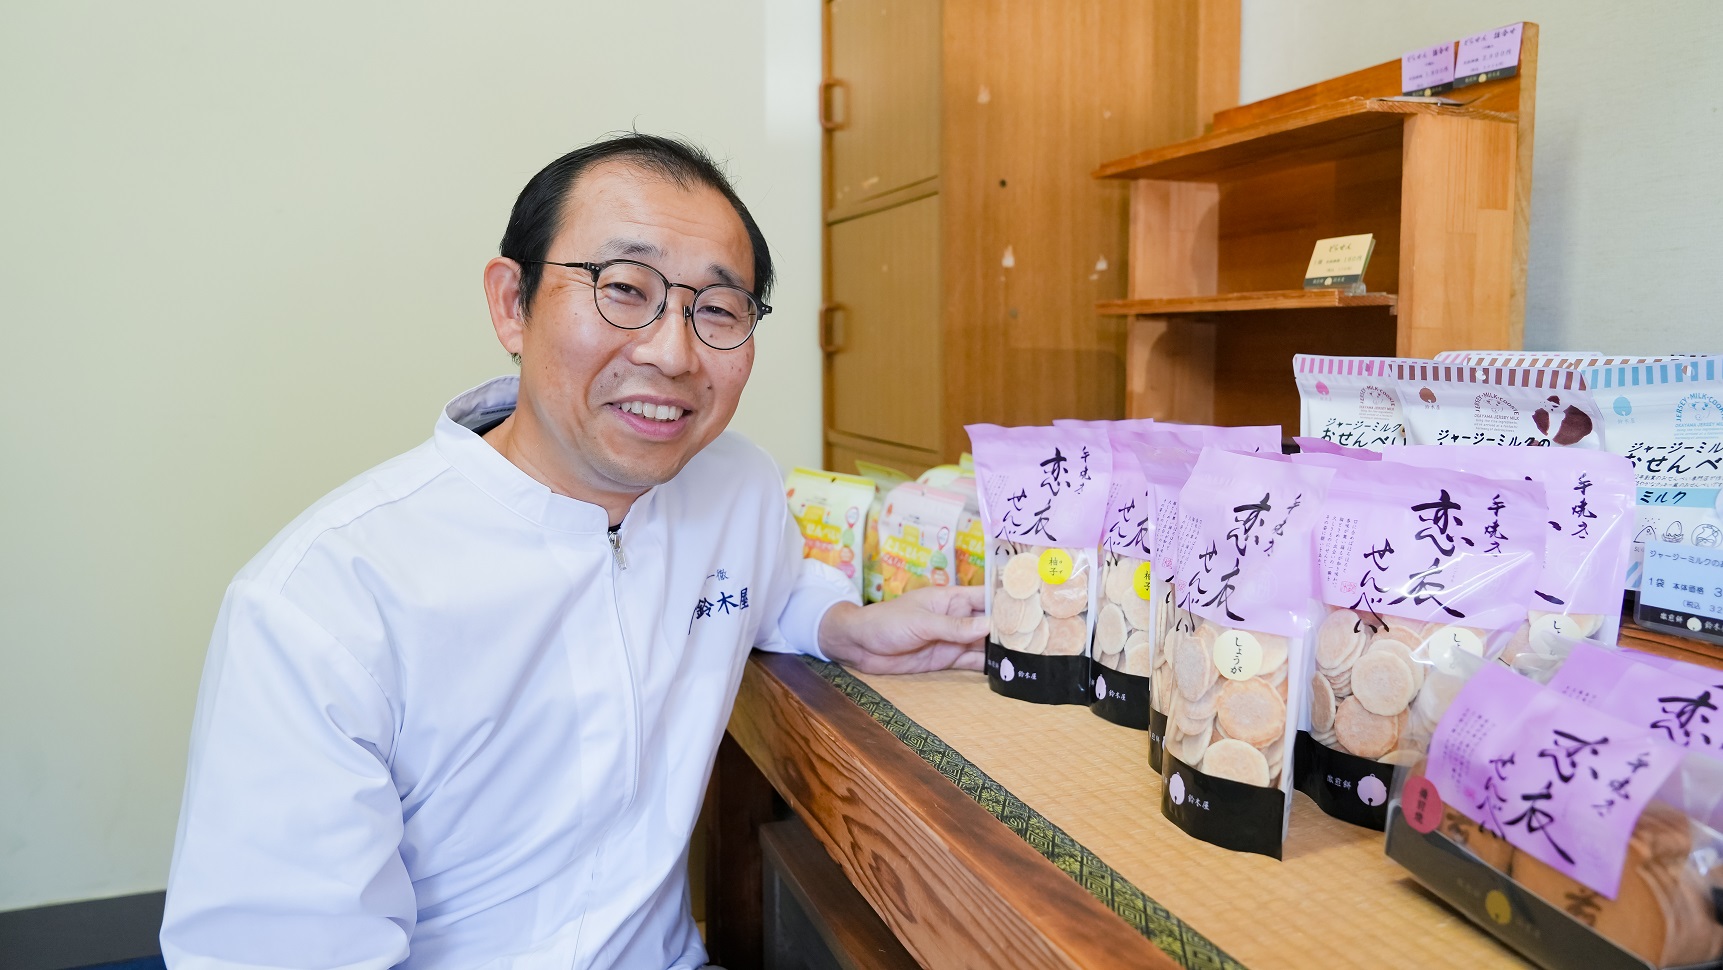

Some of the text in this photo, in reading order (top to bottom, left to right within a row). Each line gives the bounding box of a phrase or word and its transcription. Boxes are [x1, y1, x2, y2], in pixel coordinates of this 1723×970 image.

[1640, 490, 1687, 505] ミルク
[1673, 583, 1704, 595] 本体価格
[696, 587, 749, 619] 鈴木屋
[1230, 636, 1243, 675] しょうが
